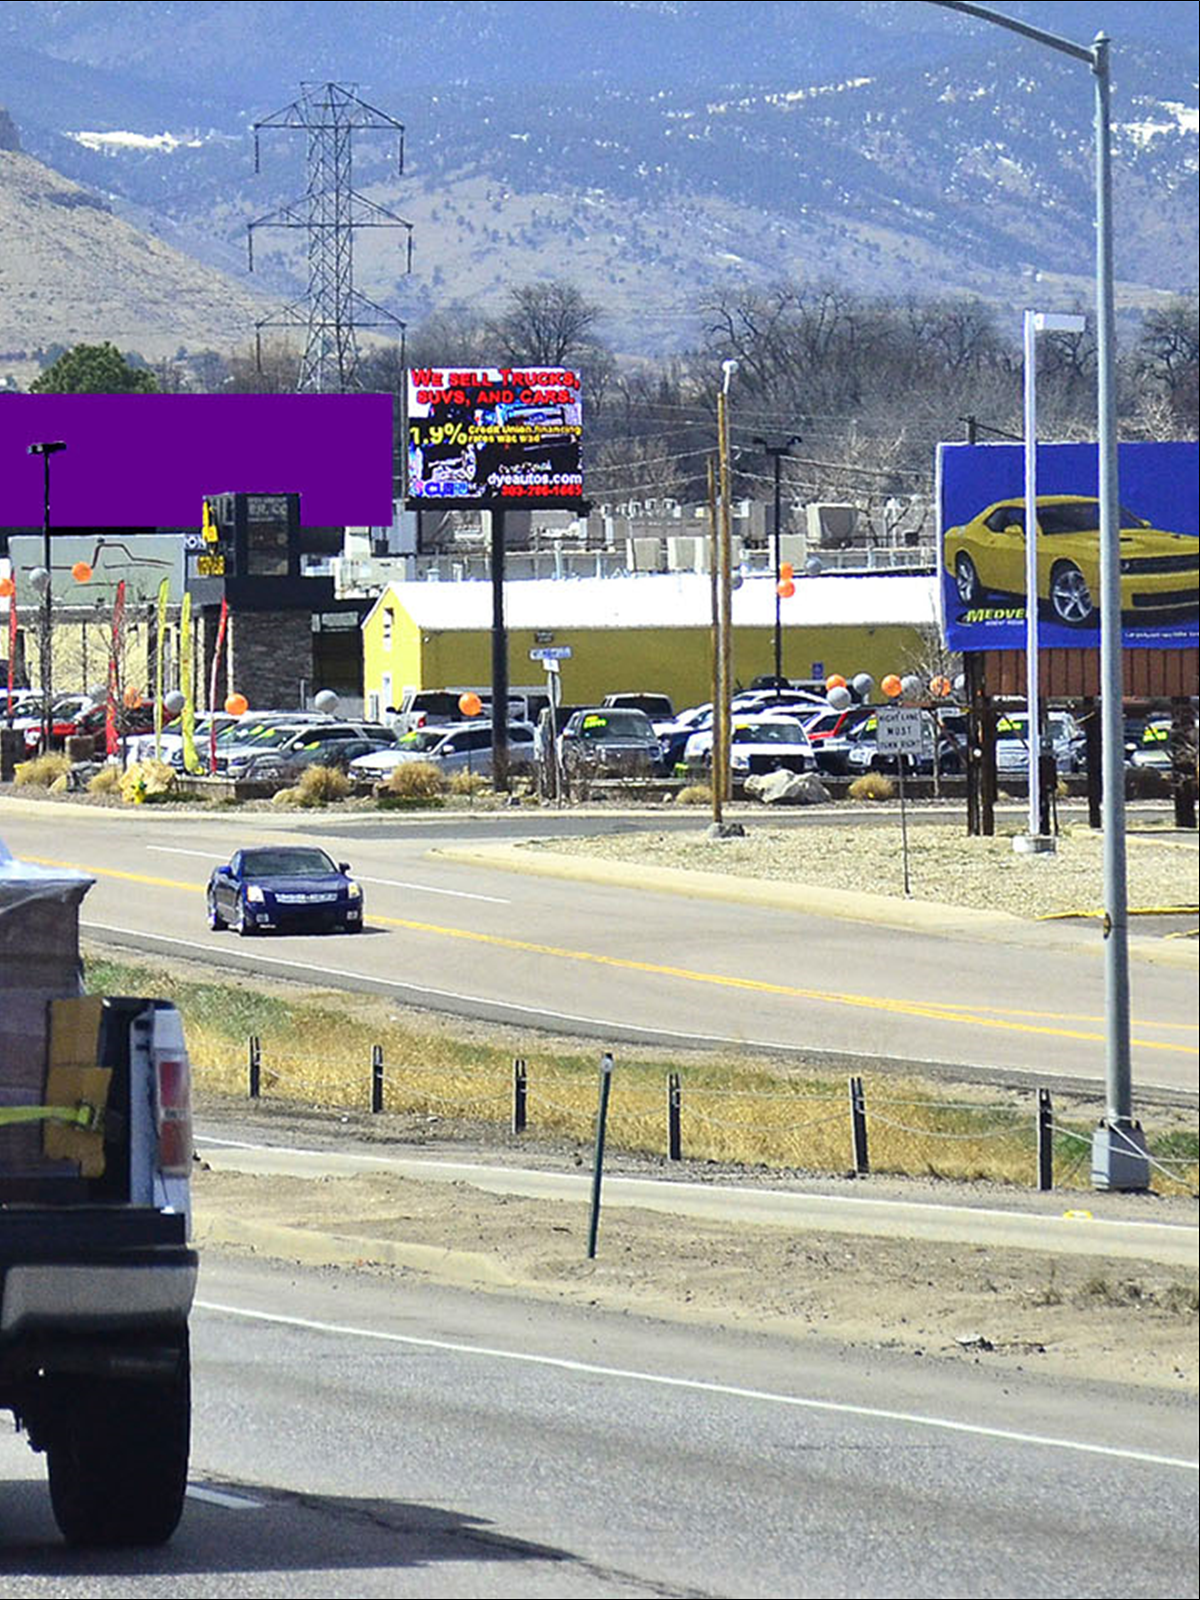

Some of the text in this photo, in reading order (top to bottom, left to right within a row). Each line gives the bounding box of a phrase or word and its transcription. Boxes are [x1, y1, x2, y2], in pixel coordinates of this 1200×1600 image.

[410, 368, 580, 390] WE SELL TRUCKS,
[416, 390, 575, 407] SUVS, AND CARS.
[409, 422, 468, 445] 1.9%
[468, 425, 500, 434] Credit
[502, 425, 532, 434] Union
[487, 472, 582, 488] dyeautos.com
[967, 608, 1026, 622] MEDVE
